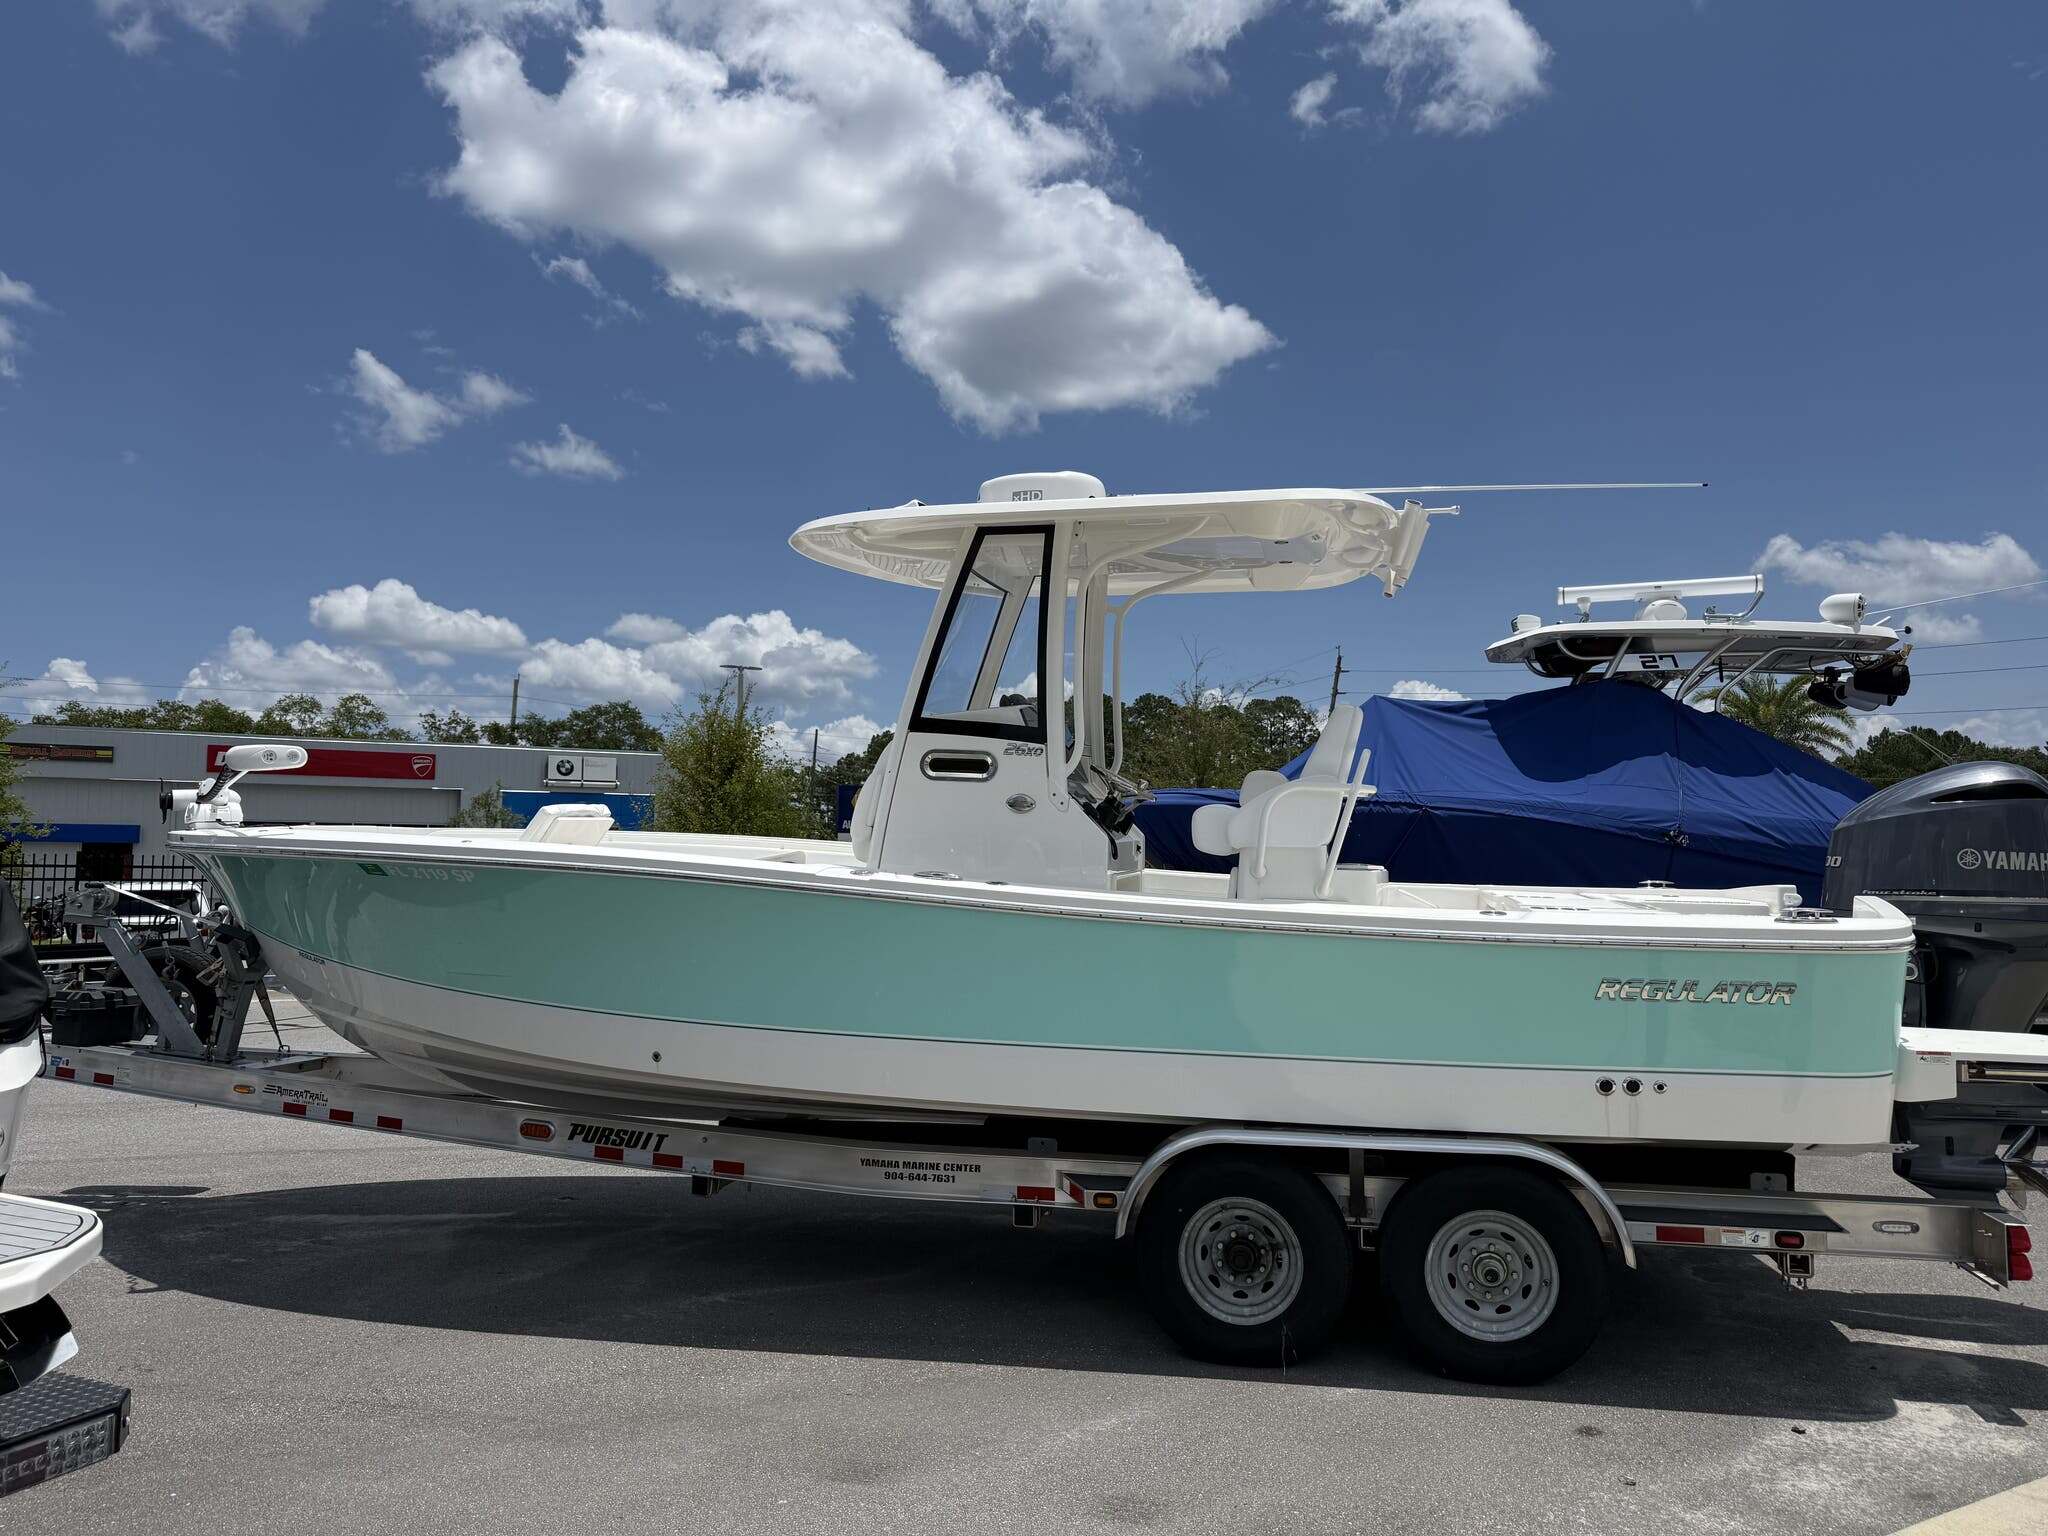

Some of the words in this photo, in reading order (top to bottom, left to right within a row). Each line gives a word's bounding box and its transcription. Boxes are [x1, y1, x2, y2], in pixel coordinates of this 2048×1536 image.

[1638, 654, 1679, 669] 27
[1595, 977, 1798, 1005] REGULATOR
[567, 1122, 669, 1152] PURSUIT
[860, 1157, 900, 1169] YAMAHA
[902, 1160, 941, 1171] MARINE
[943, 1162, 981, 1173] CENTER
[884, 1171, 955, 1183] 904-644-7631
